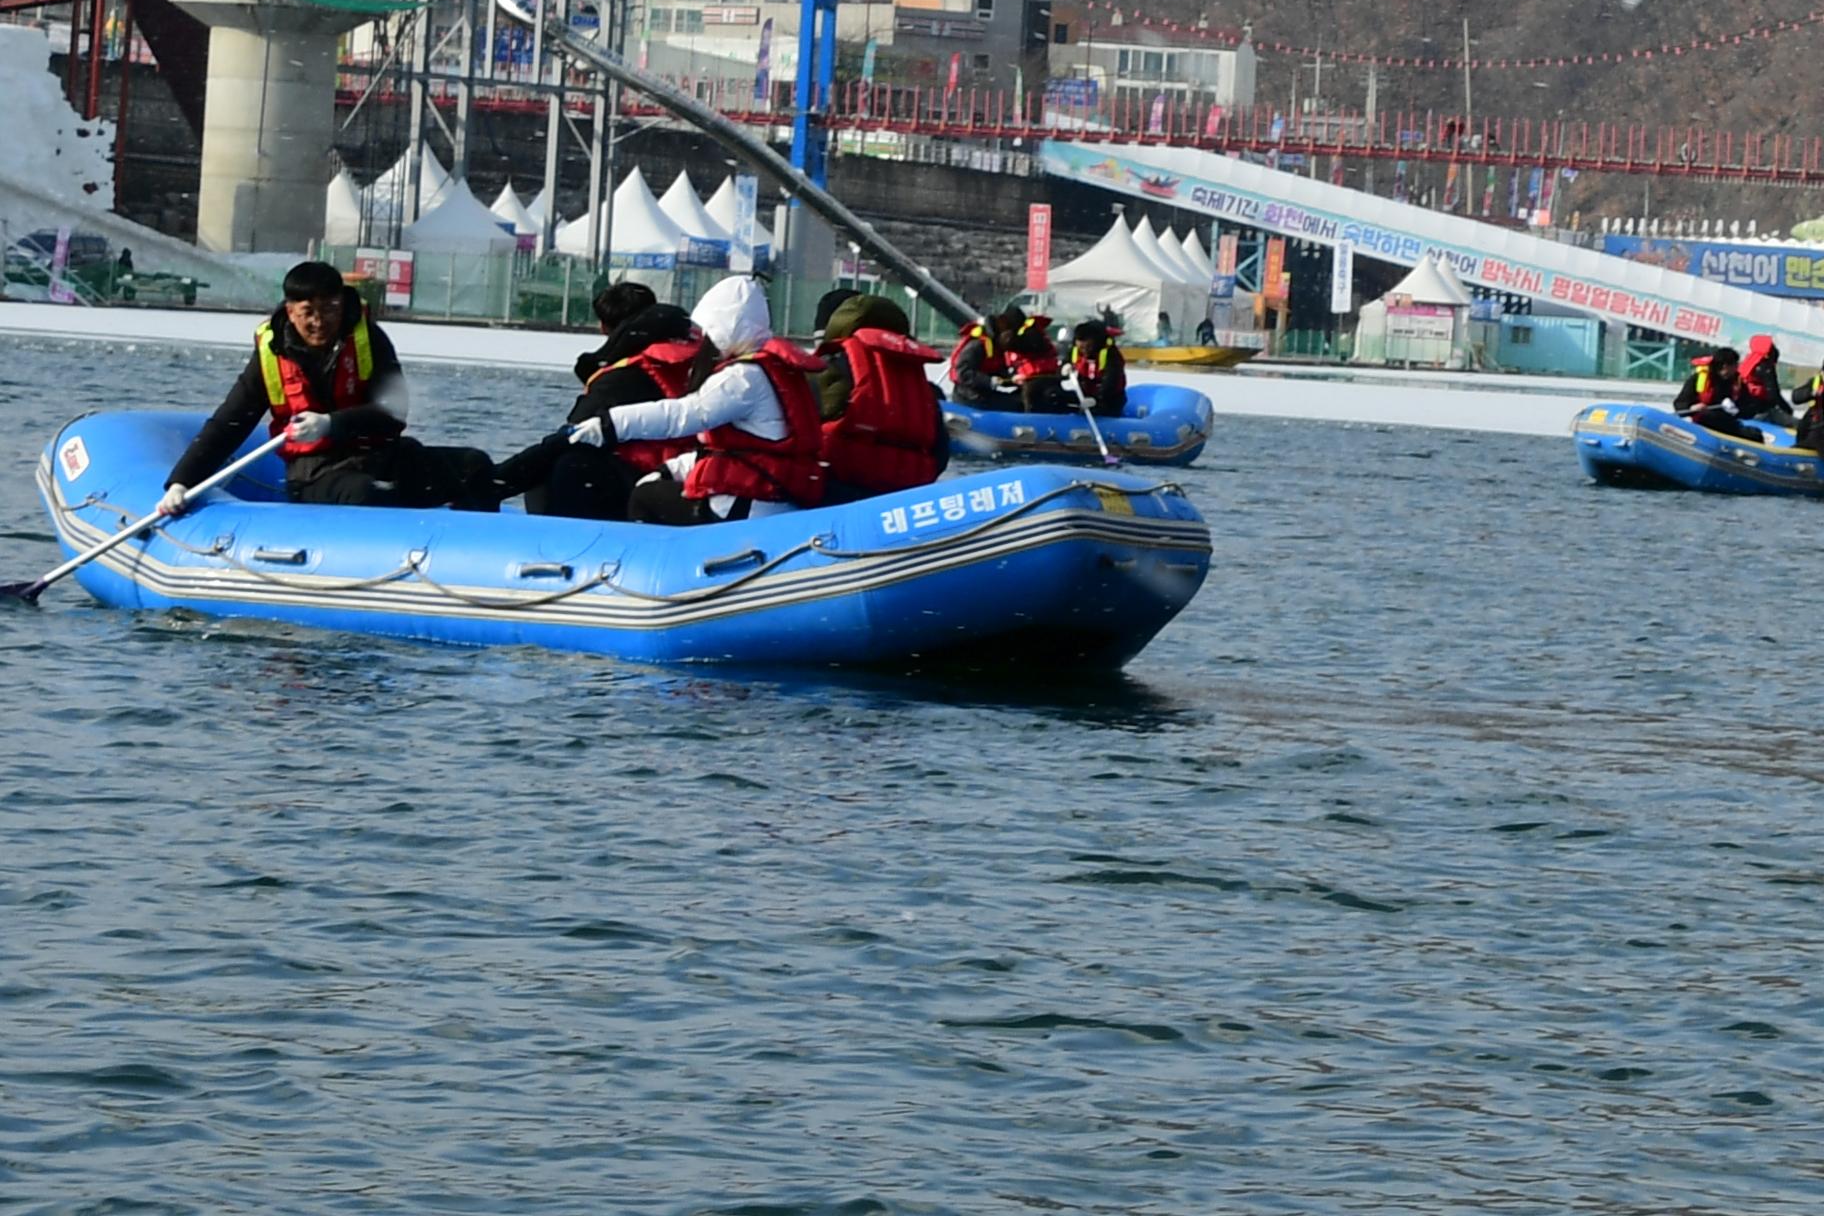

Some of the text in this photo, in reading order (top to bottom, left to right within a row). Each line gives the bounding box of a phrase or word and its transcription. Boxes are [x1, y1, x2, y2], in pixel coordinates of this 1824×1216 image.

[1191, 186, 1258, 218] 축제기간
[1263, 202, 1337, 237] 화천에서
[1342, 222, 1421, 262] 숙박하면
[1551, 275, 1669, 325] 평일얼음낚시
[1674, 307, 1720, 338] 공짜!
[1702, 249, 1779, 286] 산천어
